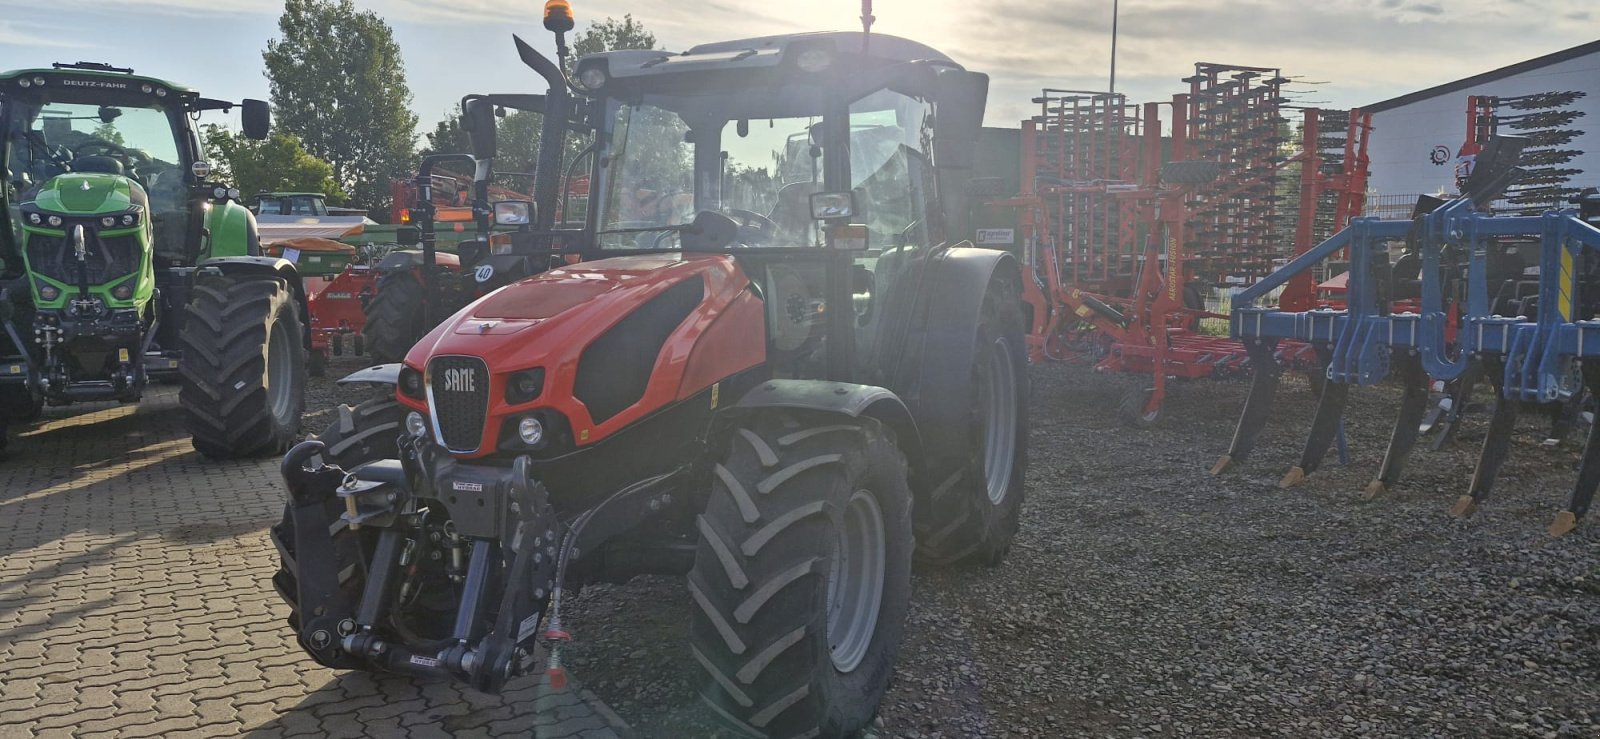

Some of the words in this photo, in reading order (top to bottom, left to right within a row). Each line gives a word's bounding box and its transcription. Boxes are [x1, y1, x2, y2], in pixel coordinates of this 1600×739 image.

[63, 79, 127, 89] DEUTZ-FAHR
[478, 267, 491, 280] 40
[444, 368, 475, 391] SAME
